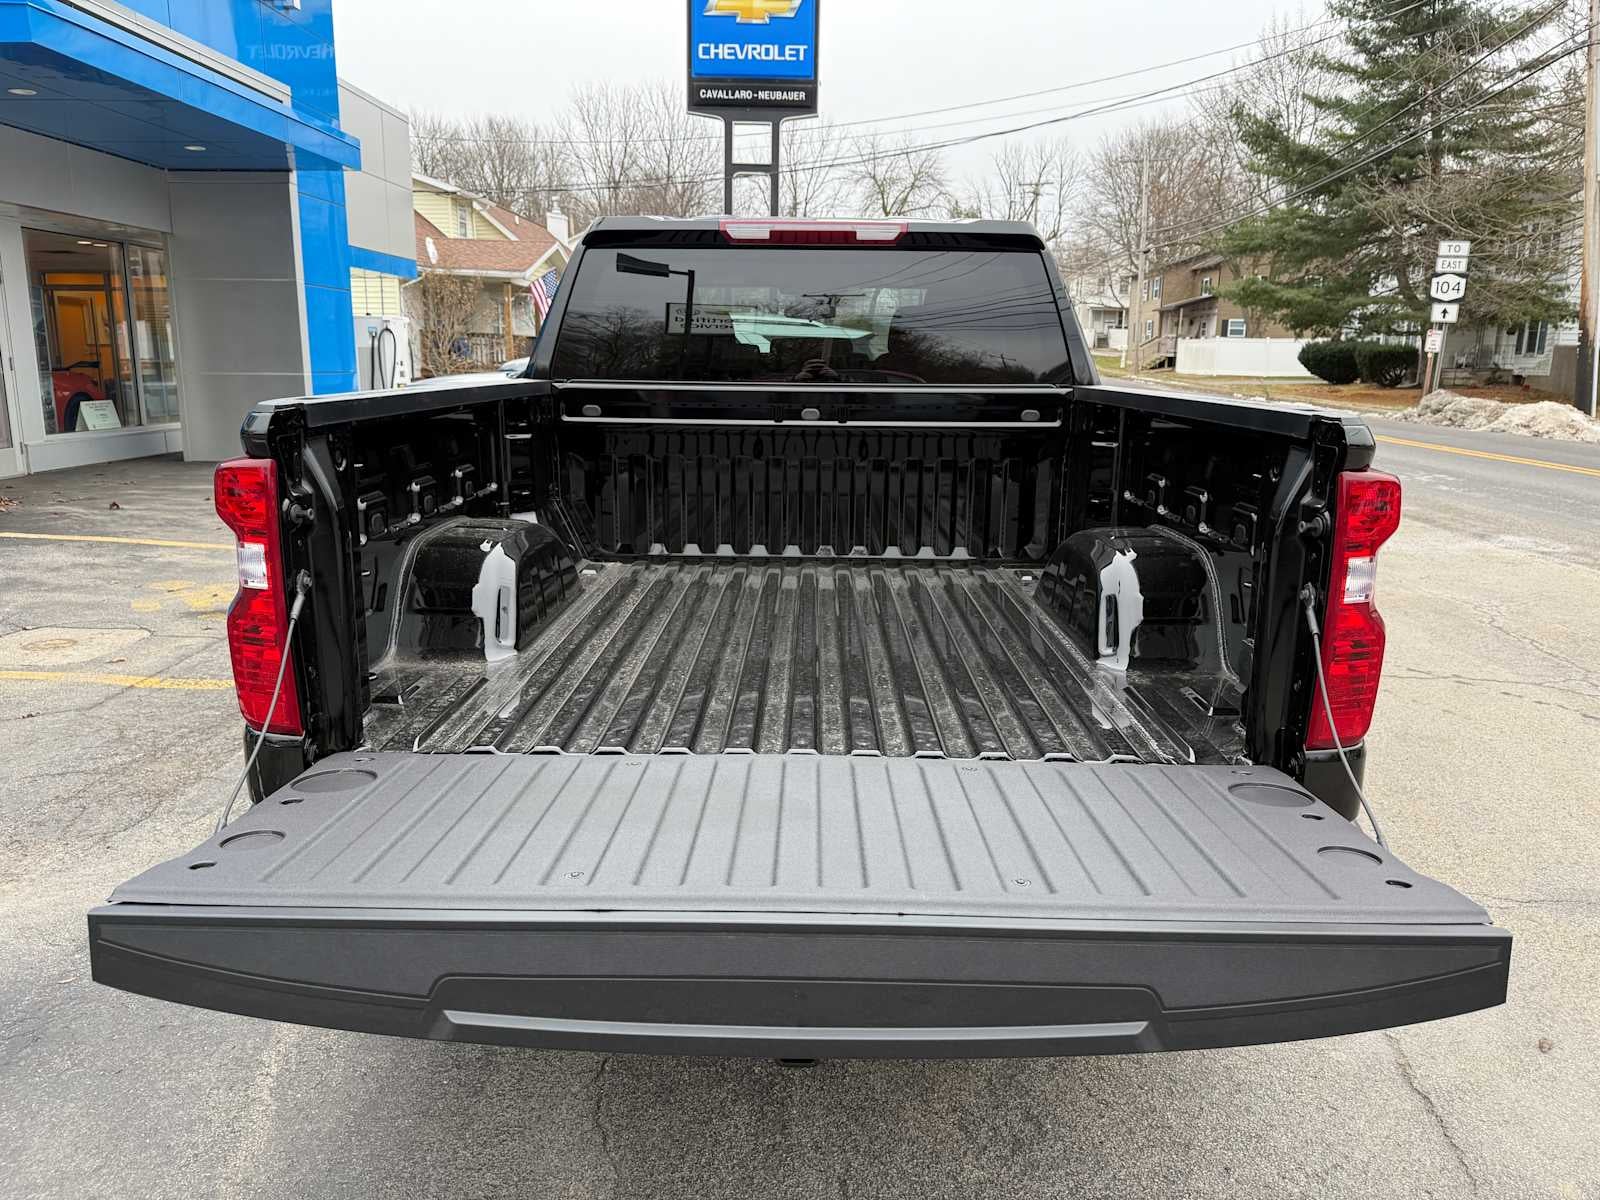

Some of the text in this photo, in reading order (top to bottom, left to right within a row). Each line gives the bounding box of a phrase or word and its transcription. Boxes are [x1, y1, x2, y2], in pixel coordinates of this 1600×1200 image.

[698, 43, 808, 61] CHEVROLET
[699, 89, 806, 101] CAVALLARO-NEUBAUER
[1447, 244, 1461, 253] TO
[1441, 260, 1462, 270] EAST
[1435, 281, 1461, 294] 104
